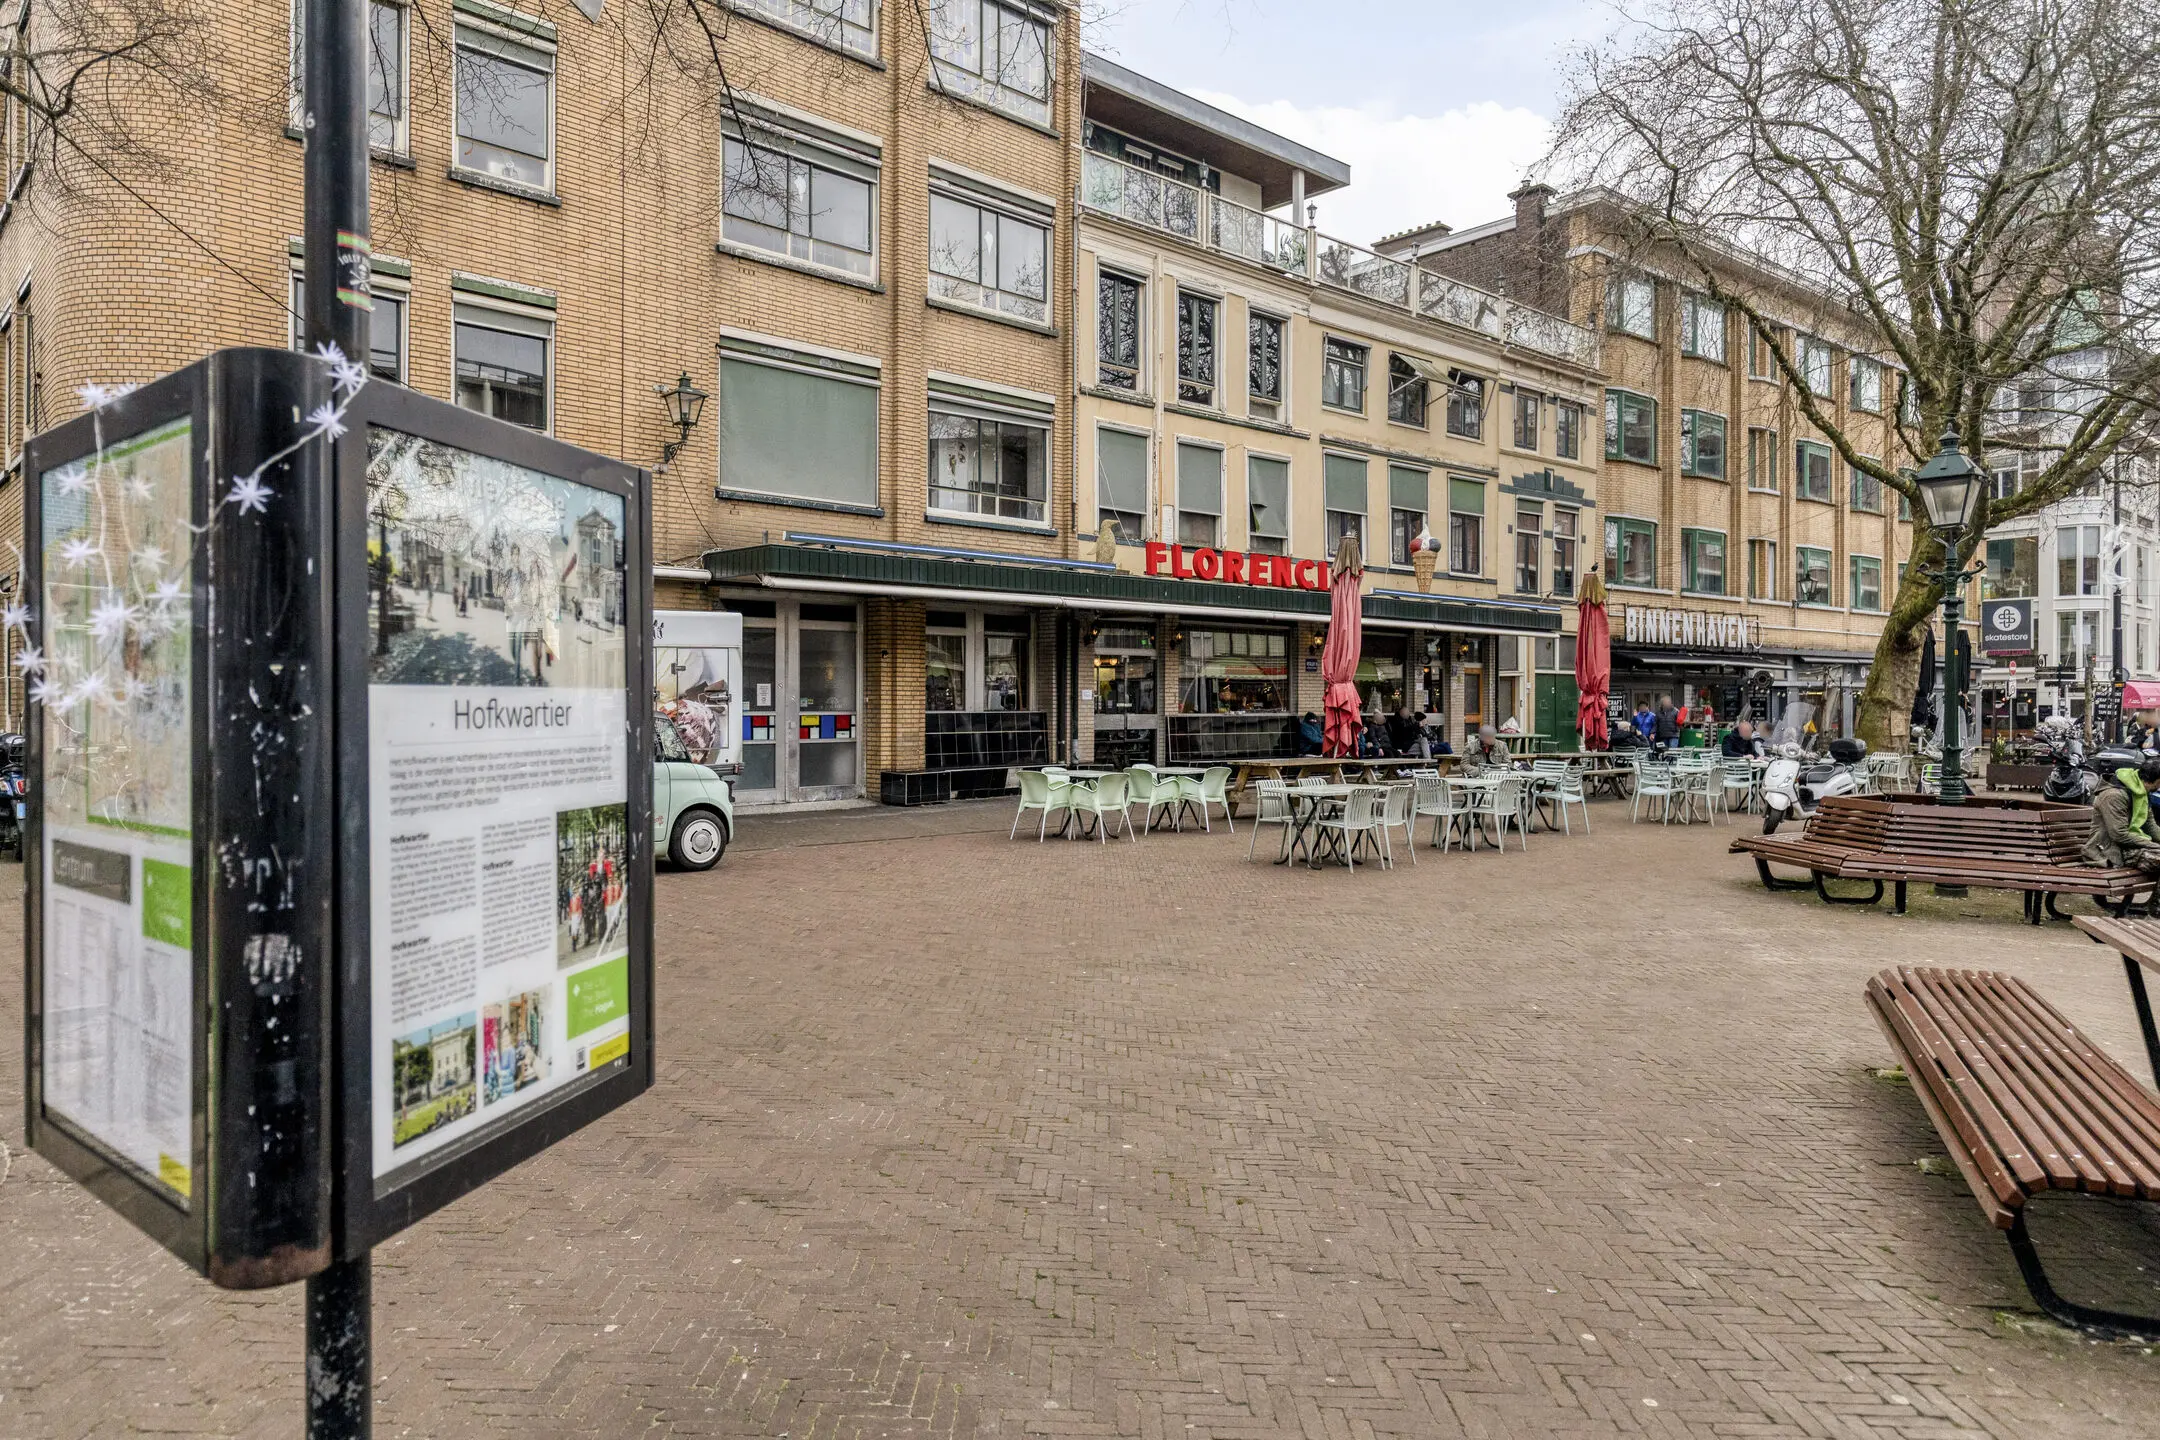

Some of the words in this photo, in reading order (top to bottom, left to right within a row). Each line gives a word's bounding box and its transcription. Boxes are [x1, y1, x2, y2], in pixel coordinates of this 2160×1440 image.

[305, 111, 316, 129] 6
[1145, 541, 1329, 592] FLORENCI
[1625, 607, 1747, 648] BINNENHAVEN
[1984, 633, 2029, 642] skatestore
[454, 698, 572, 730] Hofkwartier
[390, 832, 429, 845] Hofkwartier
